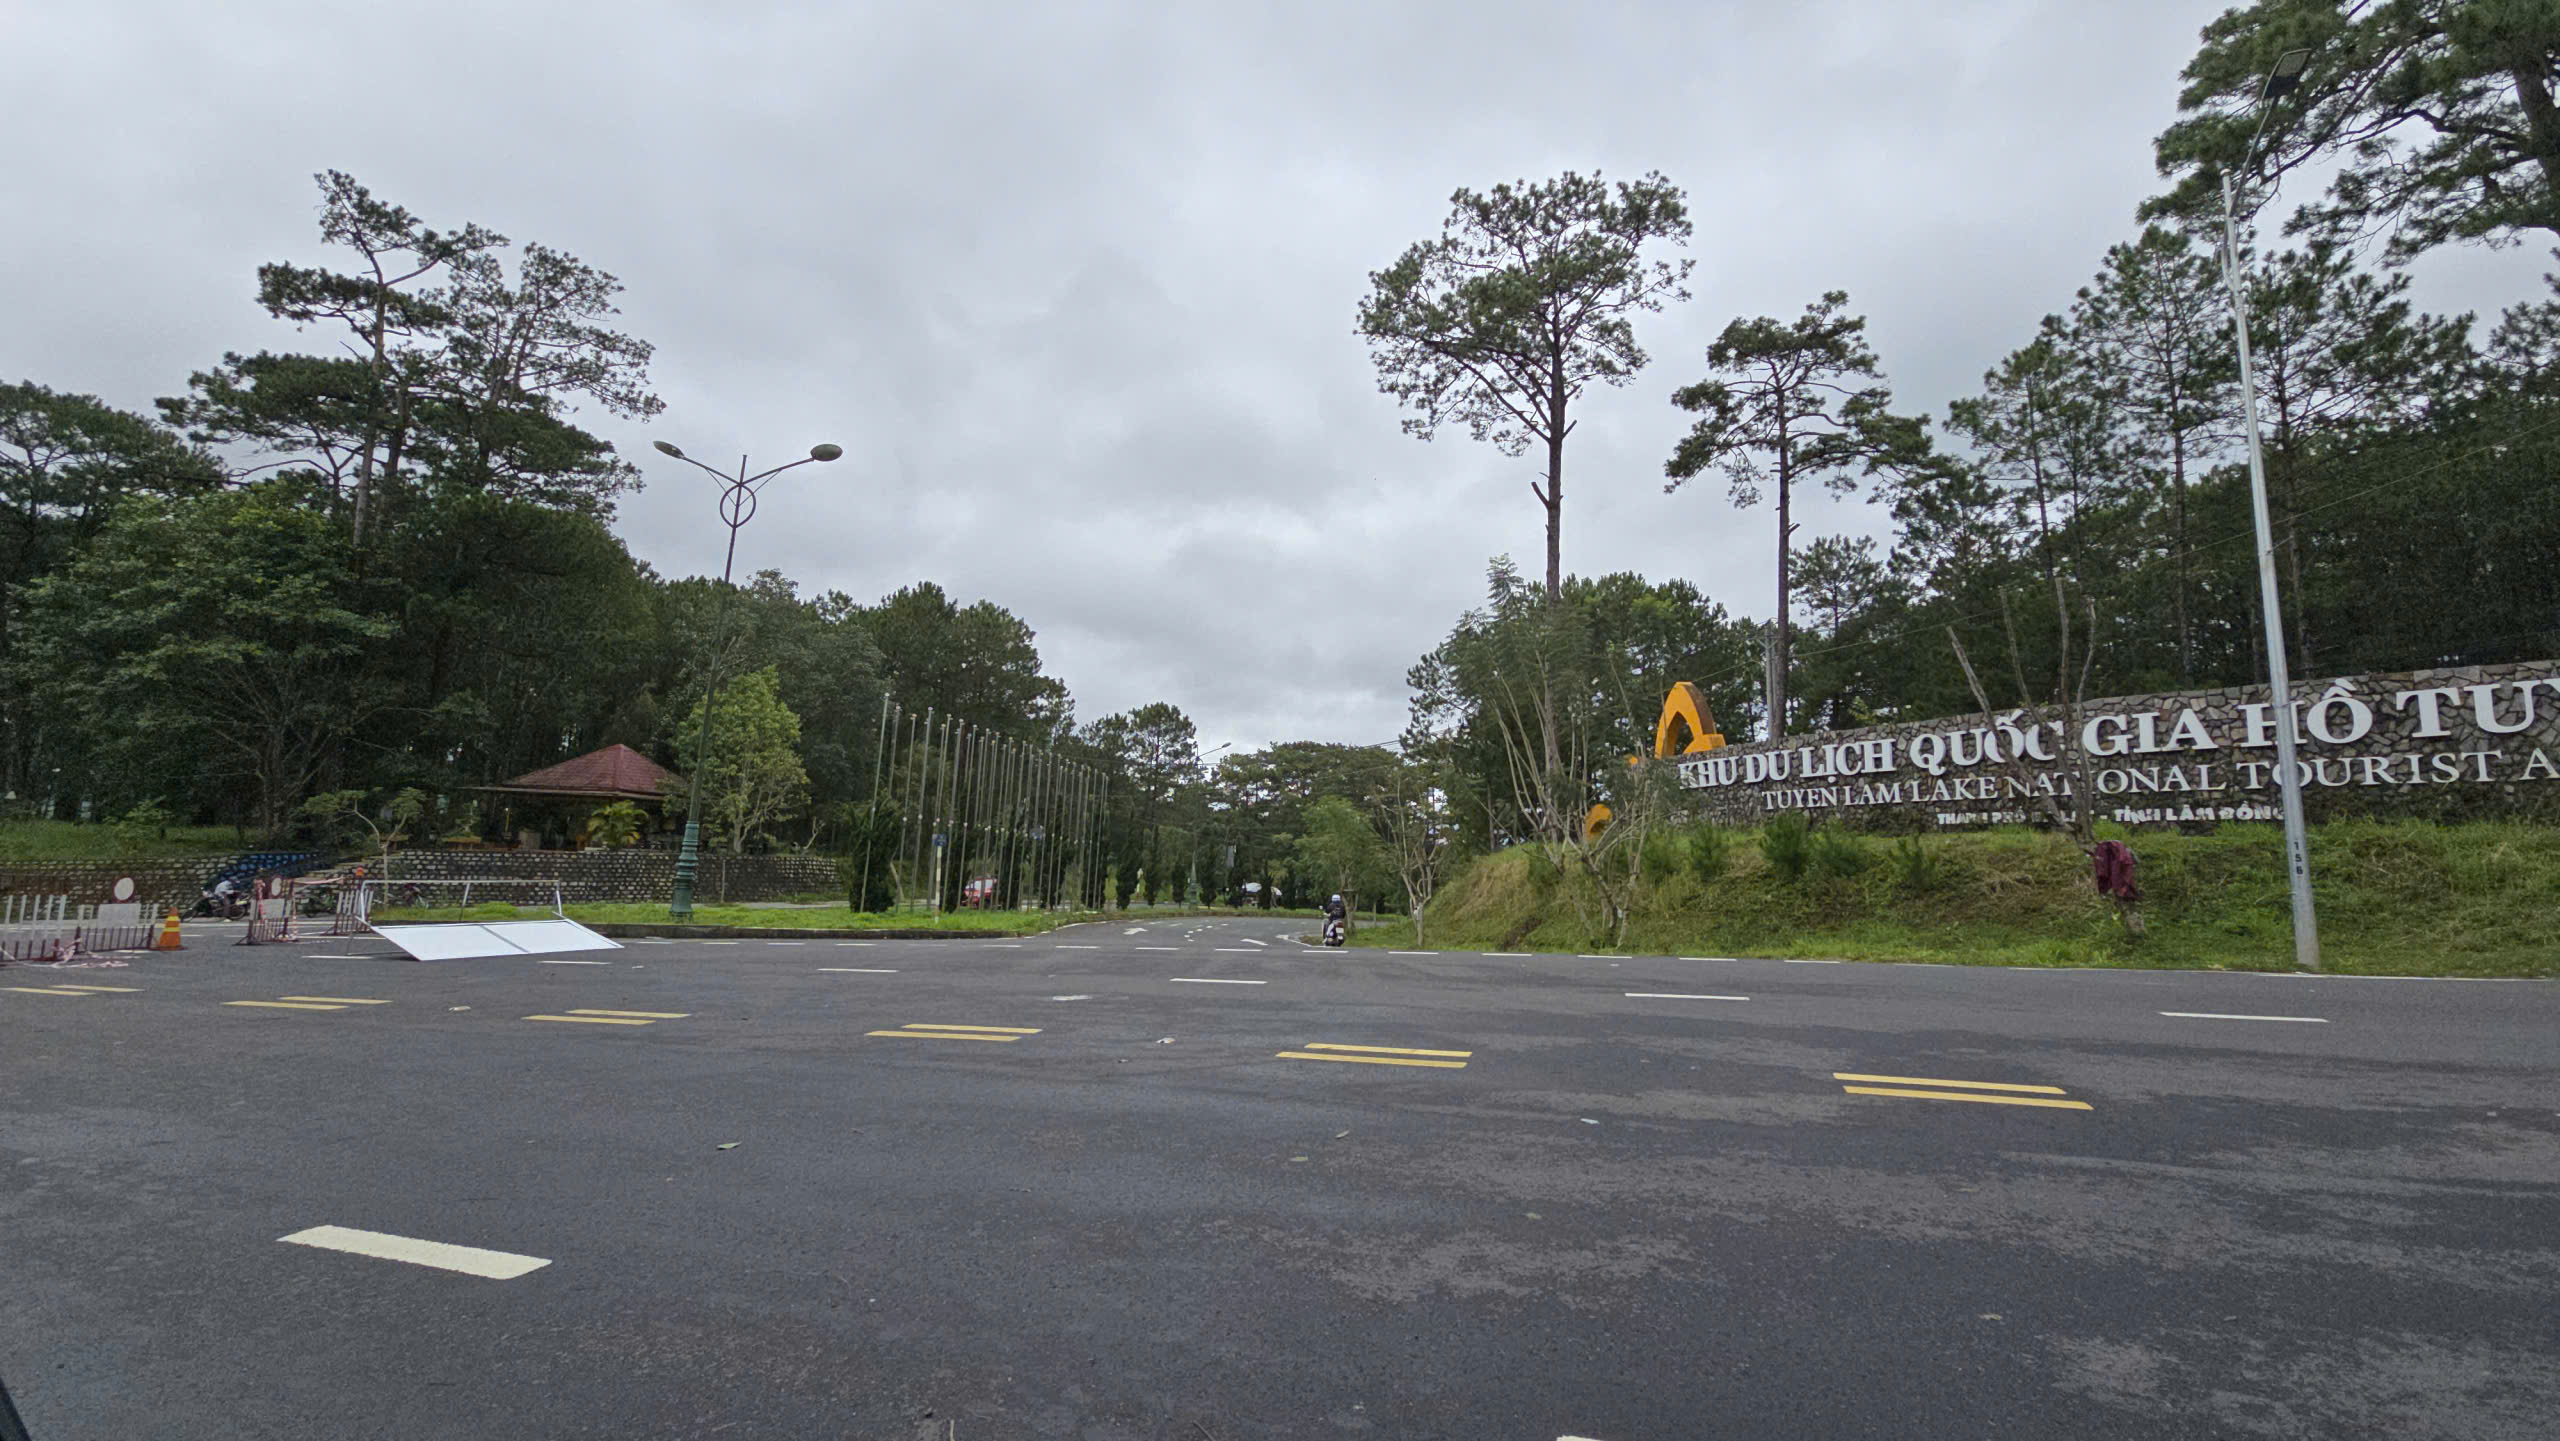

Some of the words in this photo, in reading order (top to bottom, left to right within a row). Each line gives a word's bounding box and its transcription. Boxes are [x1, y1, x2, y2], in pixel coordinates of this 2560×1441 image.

[1678, 756, 1738, 790] KHU
[1744, 749, 1793, 784] DU
[1799, 738, 1896, 784] LỊCH
[1910, 708, 2064, 776] QUỐC
[2082, 708, 2219, 756] GIA
[2396, 677, 2560, 738] TU
[1762, 785, 1839, 810] TUYEN
[1843, 782, 1903, 806] LAM
[1910, 776, 1999, 803] LAKE
[2003, 764, 2227, 799] NATONAL
[2236, 749, 2502, 790] TOURIST
